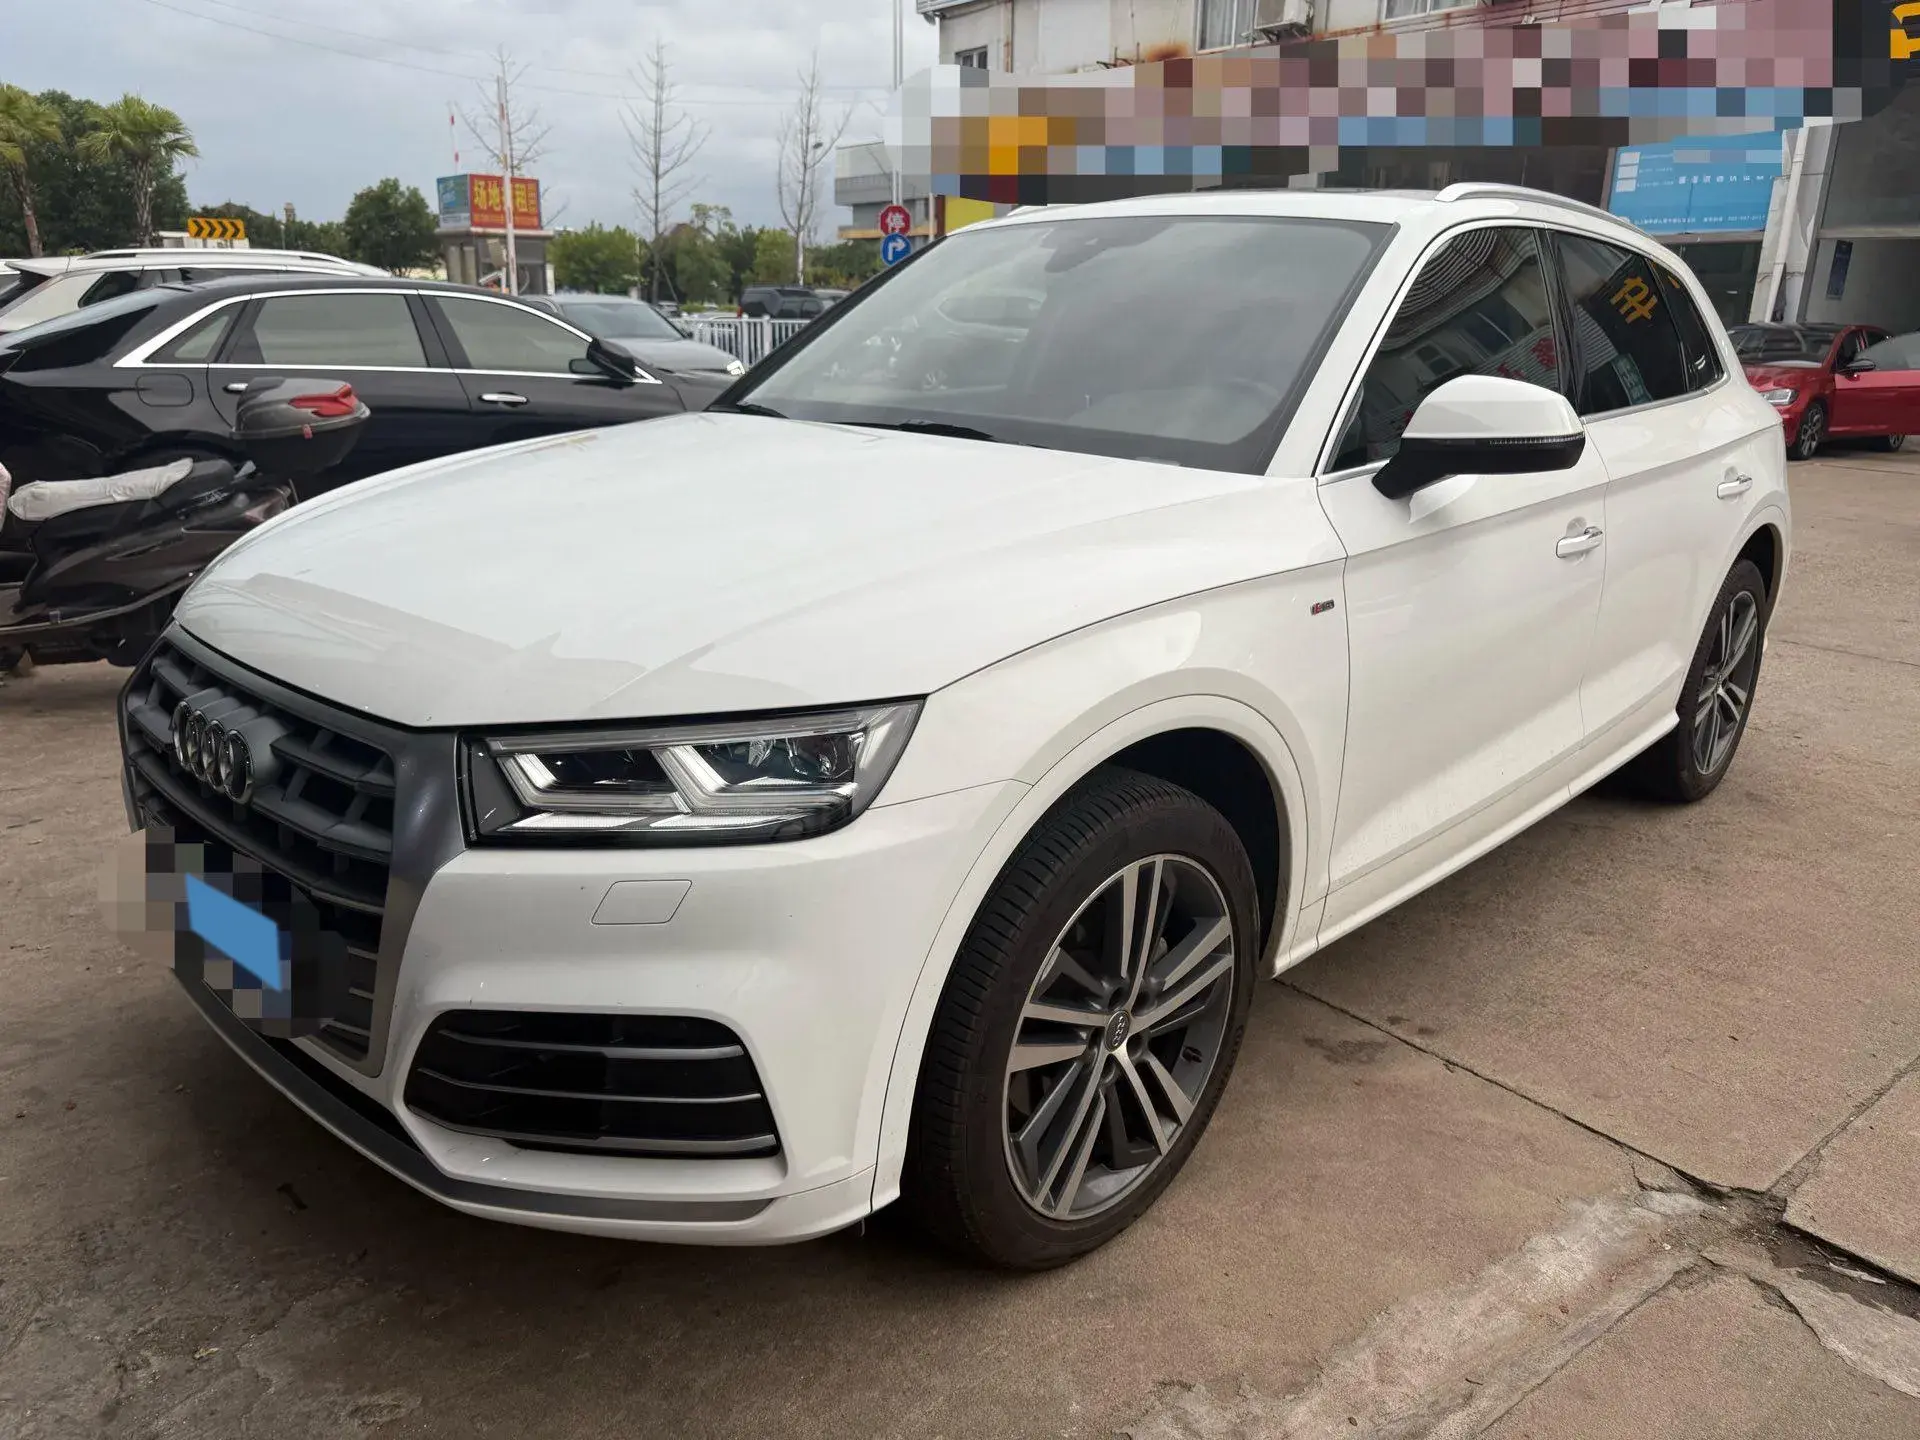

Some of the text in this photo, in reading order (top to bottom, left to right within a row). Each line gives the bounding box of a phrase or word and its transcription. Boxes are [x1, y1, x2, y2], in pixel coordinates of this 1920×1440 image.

[473, 178, 528, 212] 场地租
[886, 211, 905, 233] 停
